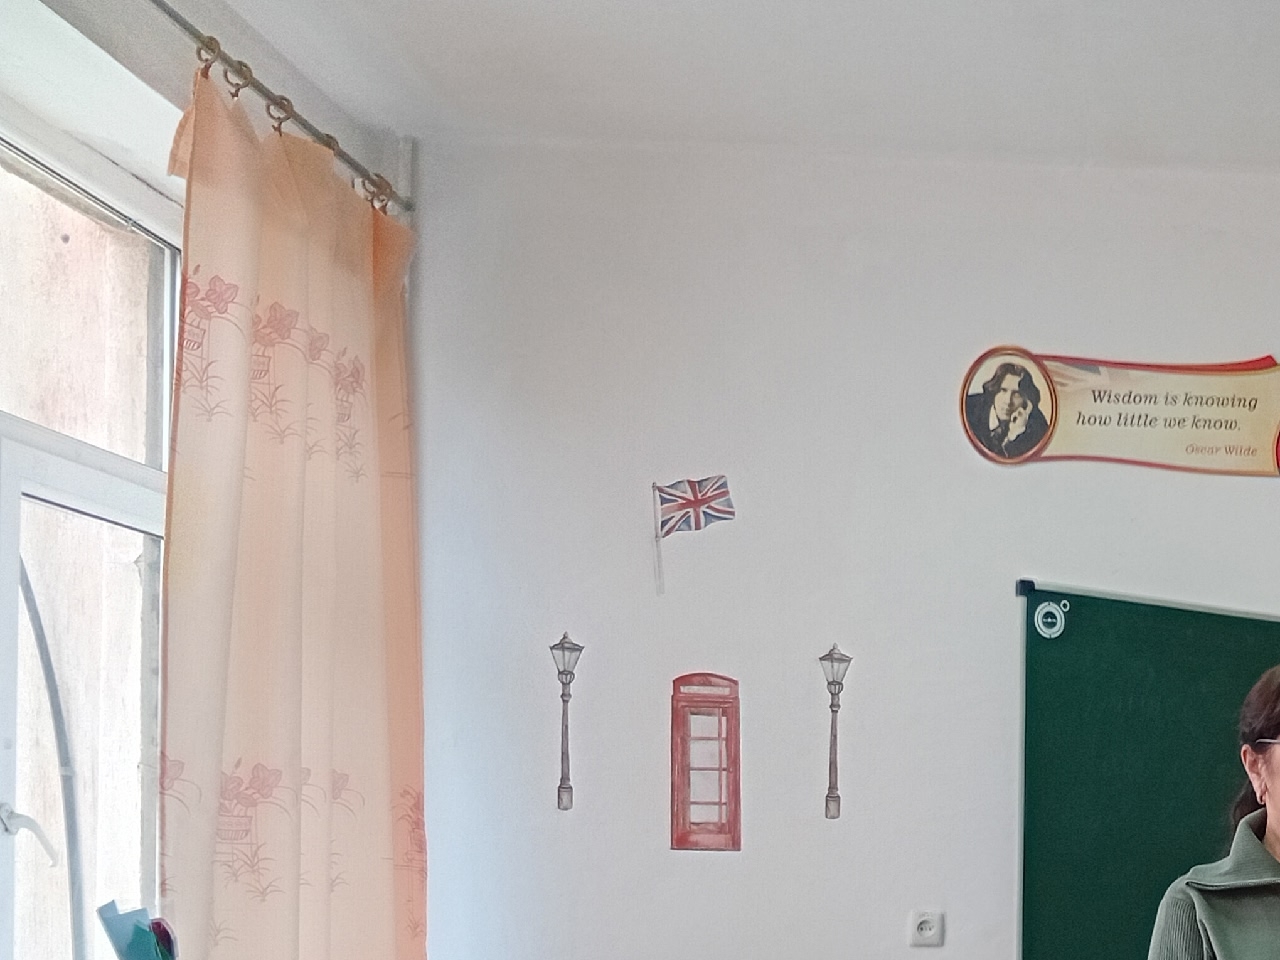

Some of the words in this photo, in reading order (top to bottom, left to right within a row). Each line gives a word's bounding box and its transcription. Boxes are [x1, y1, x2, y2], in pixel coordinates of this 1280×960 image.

[1091, 389, 1158, 406] Wisdom
[1163, 391, 1179, 407] is
[1182, 390, 1258, 411] knowing
[1076, 411, 1112, 427] how
[1116, 411, 1158, 429] little
[1163, 416, 1188, 430] we
[1191, 414, 1242, 431] know.
[1185, 443, 1221, 456] Oscar
[1223, 444, 1258, 457] Wilde
